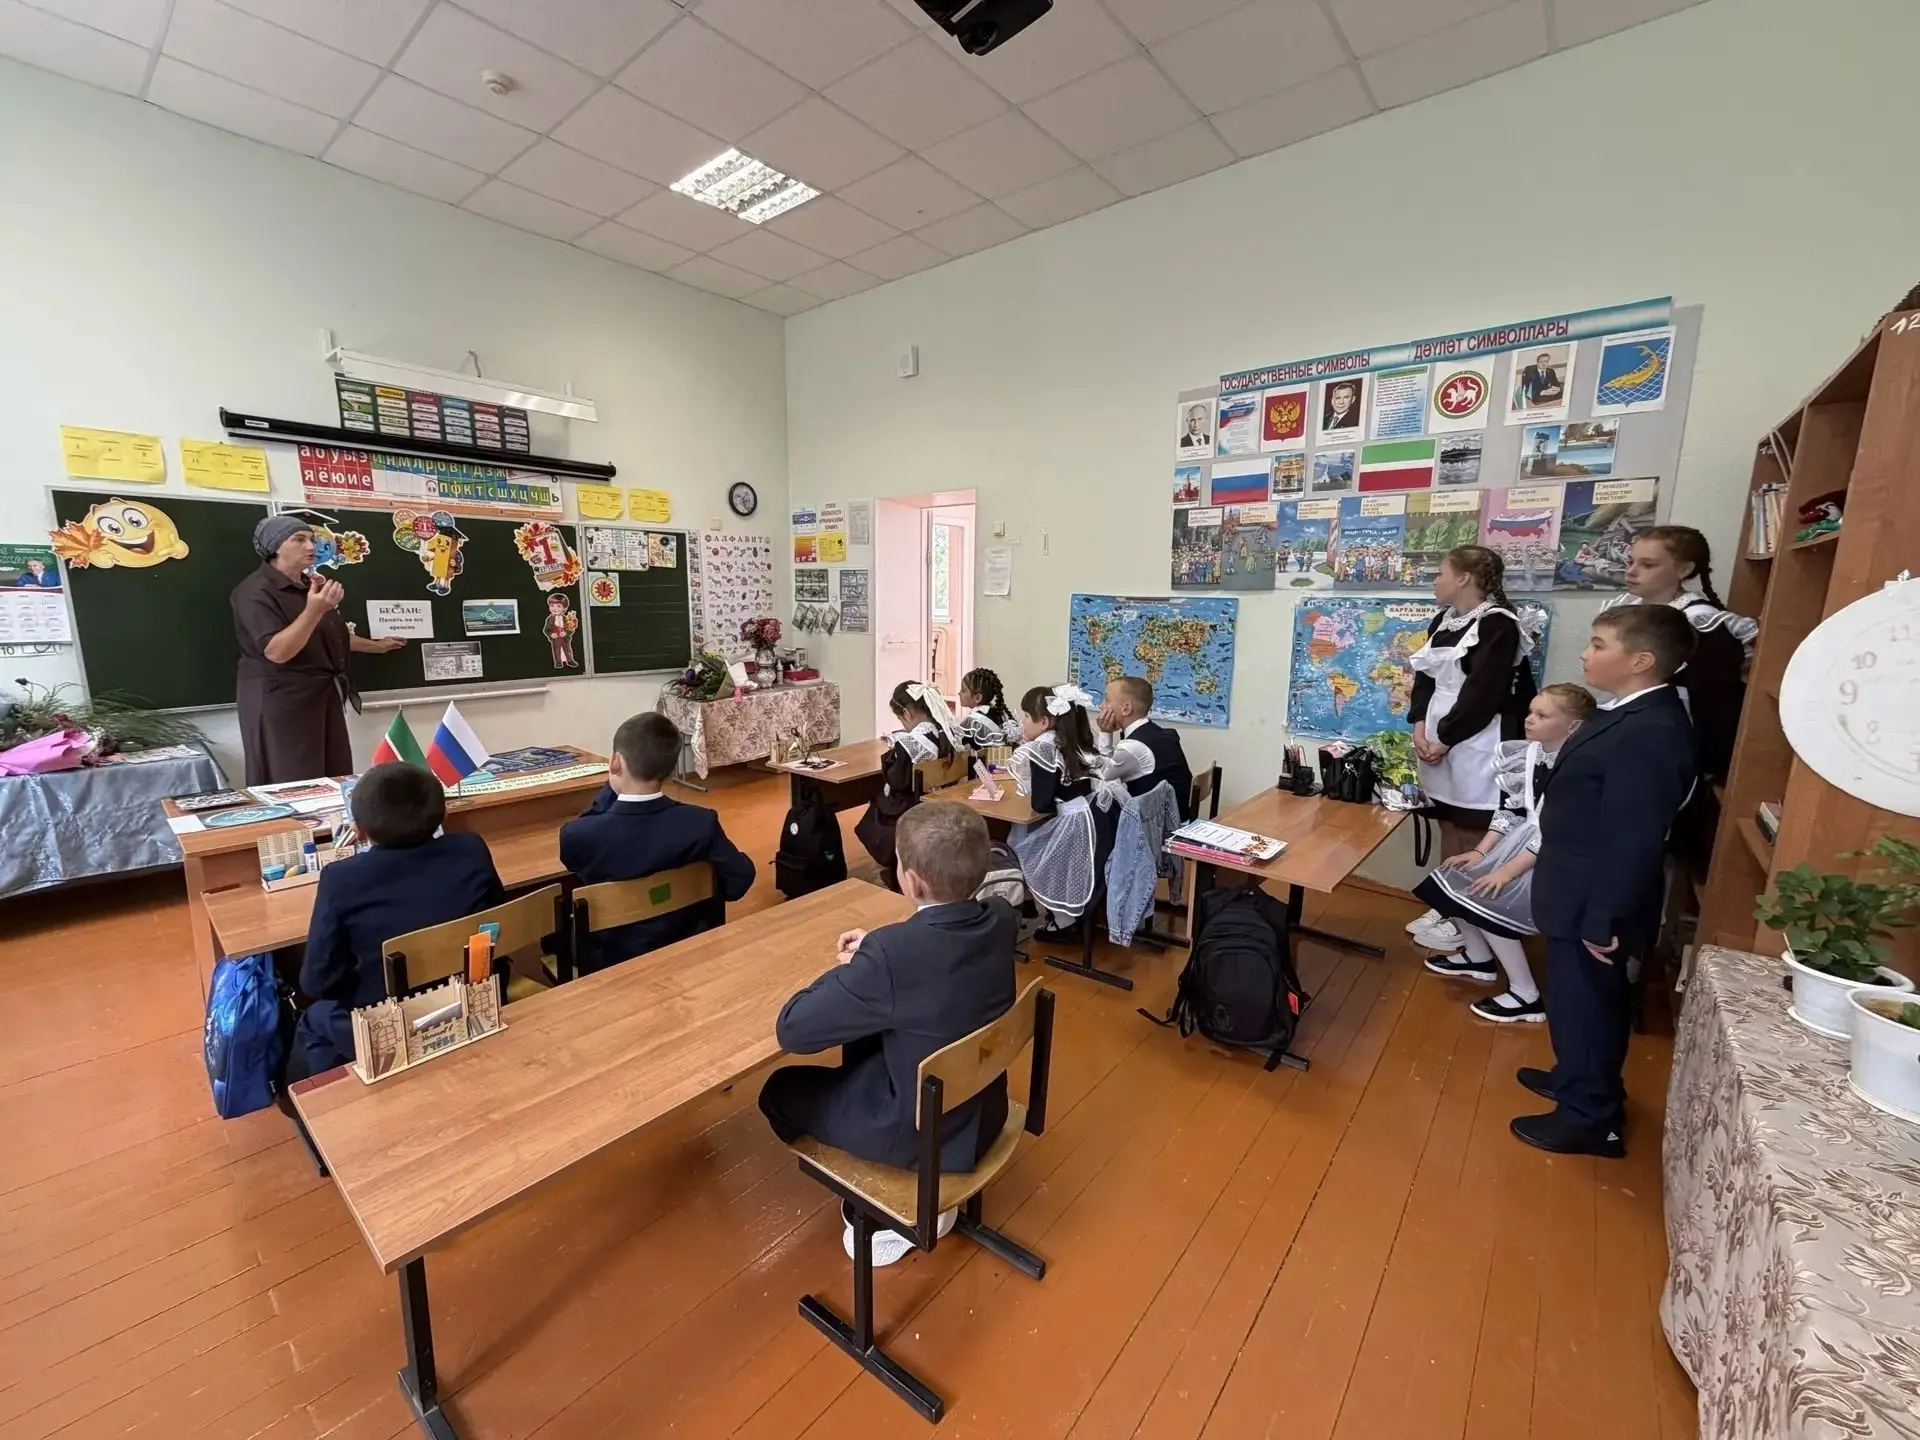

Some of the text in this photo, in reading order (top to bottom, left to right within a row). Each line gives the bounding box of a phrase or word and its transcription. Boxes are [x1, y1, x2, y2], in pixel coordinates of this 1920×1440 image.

[1414, 320, 1570, 361] ДӘҮЛӘТ СИМВОЛЛАРЫ
[1220, 352, 1371, 391] ГОСУДАРСТВЕННЫЕ СИМВОЛЫ
[714, 536, 764, 544] АЛФАВИТ
[1850, 650, 1877, 670] 10
[1838, 679, 1858, 706] 9
[1866, 720, 1881, 745] 8
